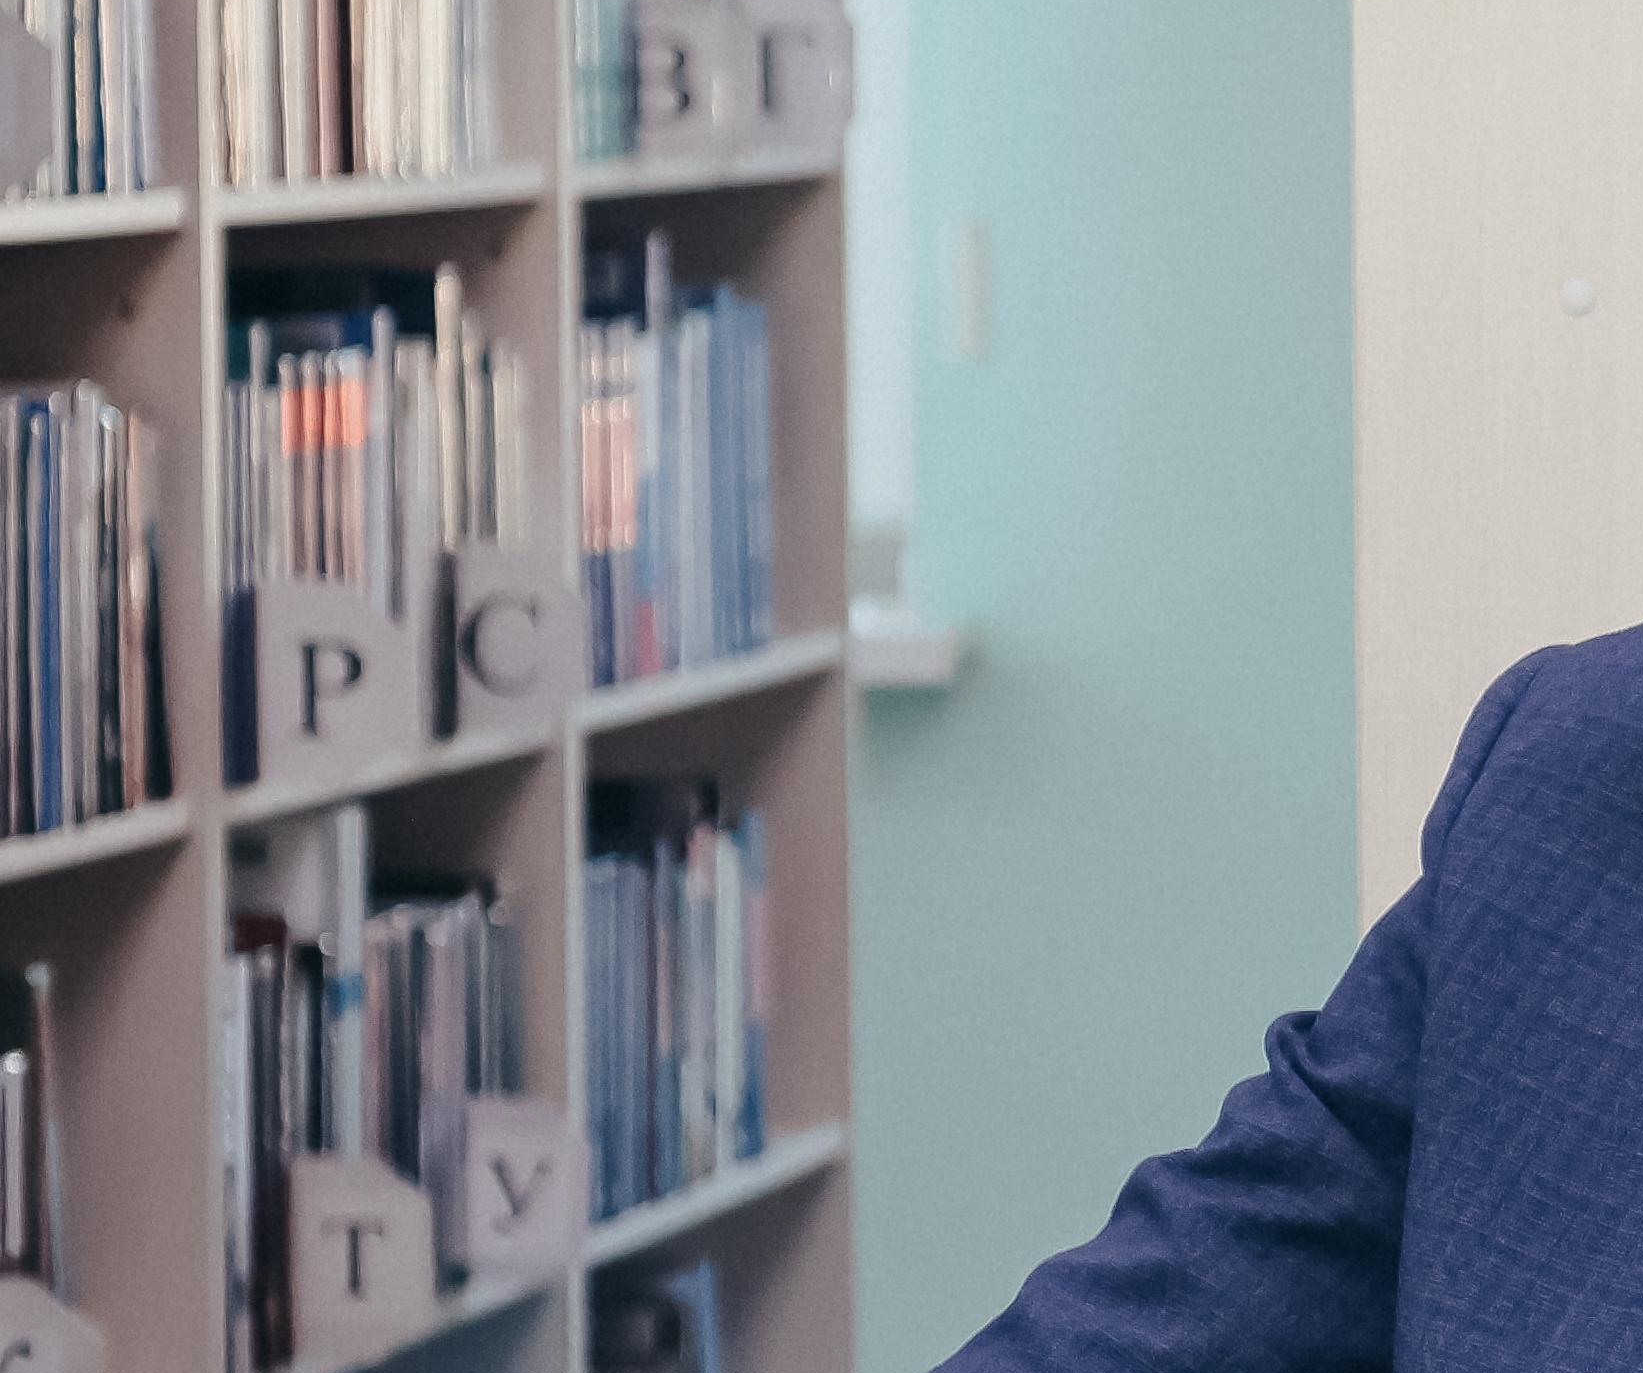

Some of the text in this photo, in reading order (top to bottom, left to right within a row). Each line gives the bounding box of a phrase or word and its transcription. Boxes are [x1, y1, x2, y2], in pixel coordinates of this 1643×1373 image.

[300, 634, 364, 738] Р
[456, 589, 544, 699] С
[319, 1213, 385, 1297] Т
